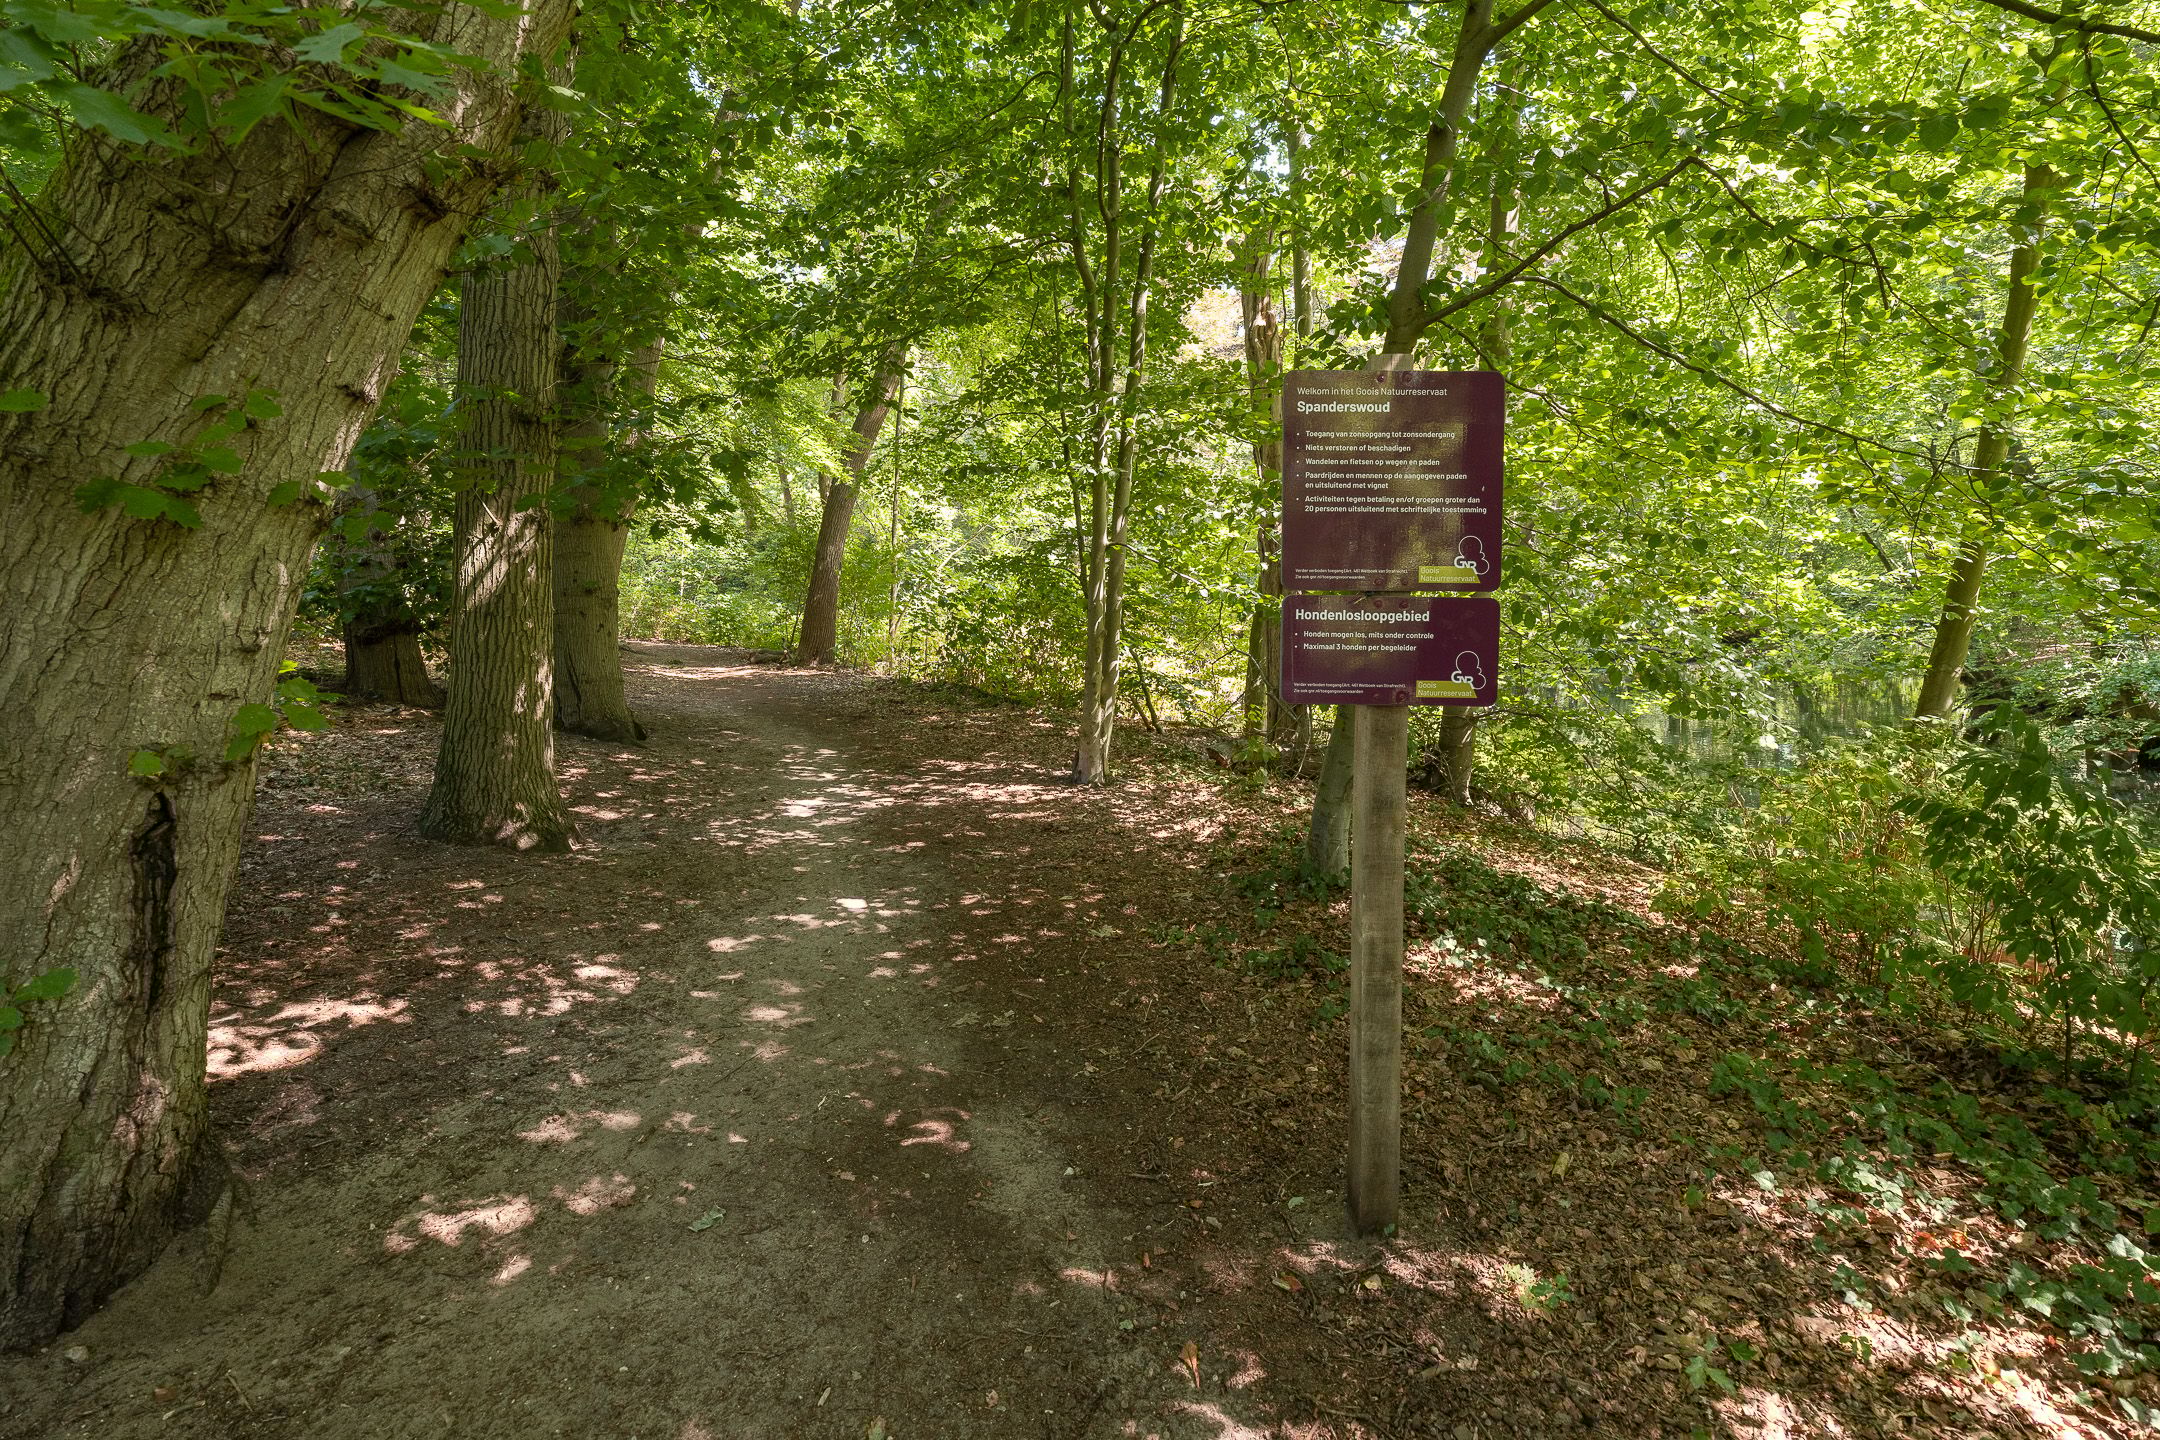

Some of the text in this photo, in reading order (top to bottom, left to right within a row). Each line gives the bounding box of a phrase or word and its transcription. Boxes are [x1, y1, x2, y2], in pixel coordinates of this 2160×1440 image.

[1297, 387, 1330, 395] Welkom
[1332, 387, 1338, 395] in
[1340, 387, 1354, 395] het
[1356, 388, 1379, 396] Goois
[1297, 401, 1390, 414] Spanderswoud
[1454, 556, 1478, 572] GNR
[1296, 609, 1430, 623] Hondenlosloopgebied
[1450, 671, 1475, 687] GNR
